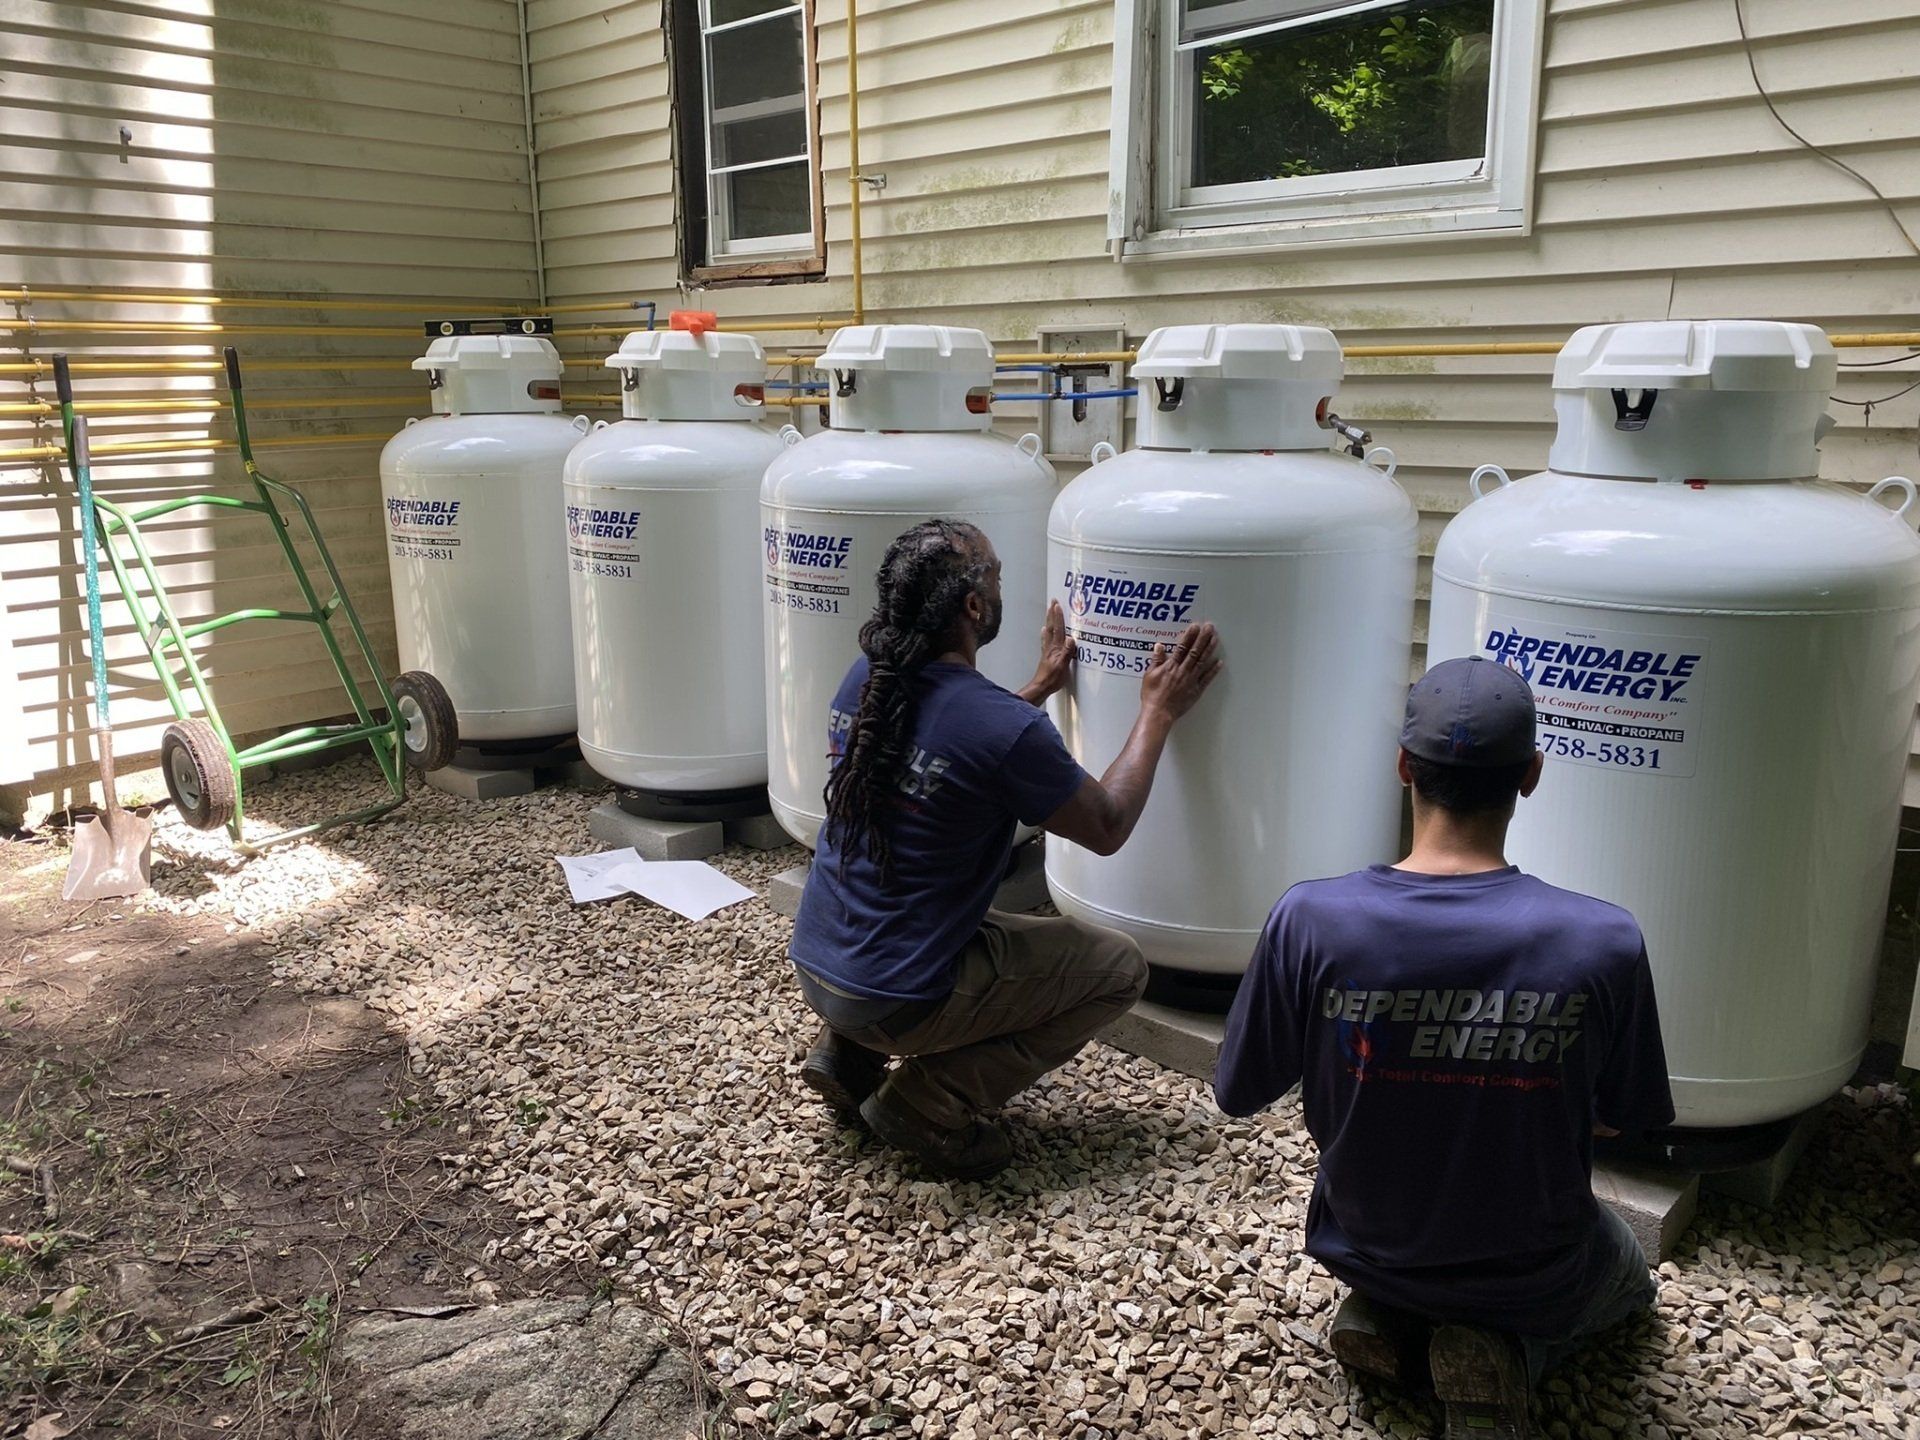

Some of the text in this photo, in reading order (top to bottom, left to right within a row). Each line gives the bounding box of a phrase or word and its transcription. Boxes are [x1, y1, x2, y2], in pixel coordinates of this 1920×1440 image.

[387, 498, 460, 513] DEPENDABLE
[567, 506, 640, 525] DEPENDABLE
[403, 513, 456, 526] ENERGY
[581, 523, 637, 539] ENERGY
[765, 528, 853, 552] DEPENDABLE
[782, 549, 847, 568] ENERGY
[818, 586, 848, 595] PROPANE
[1064, 571, 1200, 602] DEPENDABLE
[1094, 597, 1190, 622] ENERGY
[1101, 622, 1133, 634] Comfort
[1485, 630, 1701, 677] DEPENDABLE
[1538, 667, 1687, 702] ENERGY
[1549, 696, 1600, 712] Comfort
[1551, 716, 1570, 727] OIL
[1577, 718, 1614, 733] HVA/C
[1621, 727, 1683, 741] PROPANE
[1322, 988, 1589, 1026] DEPENDABLE
[1409, 1025, 1583, 1063] ENERGY
